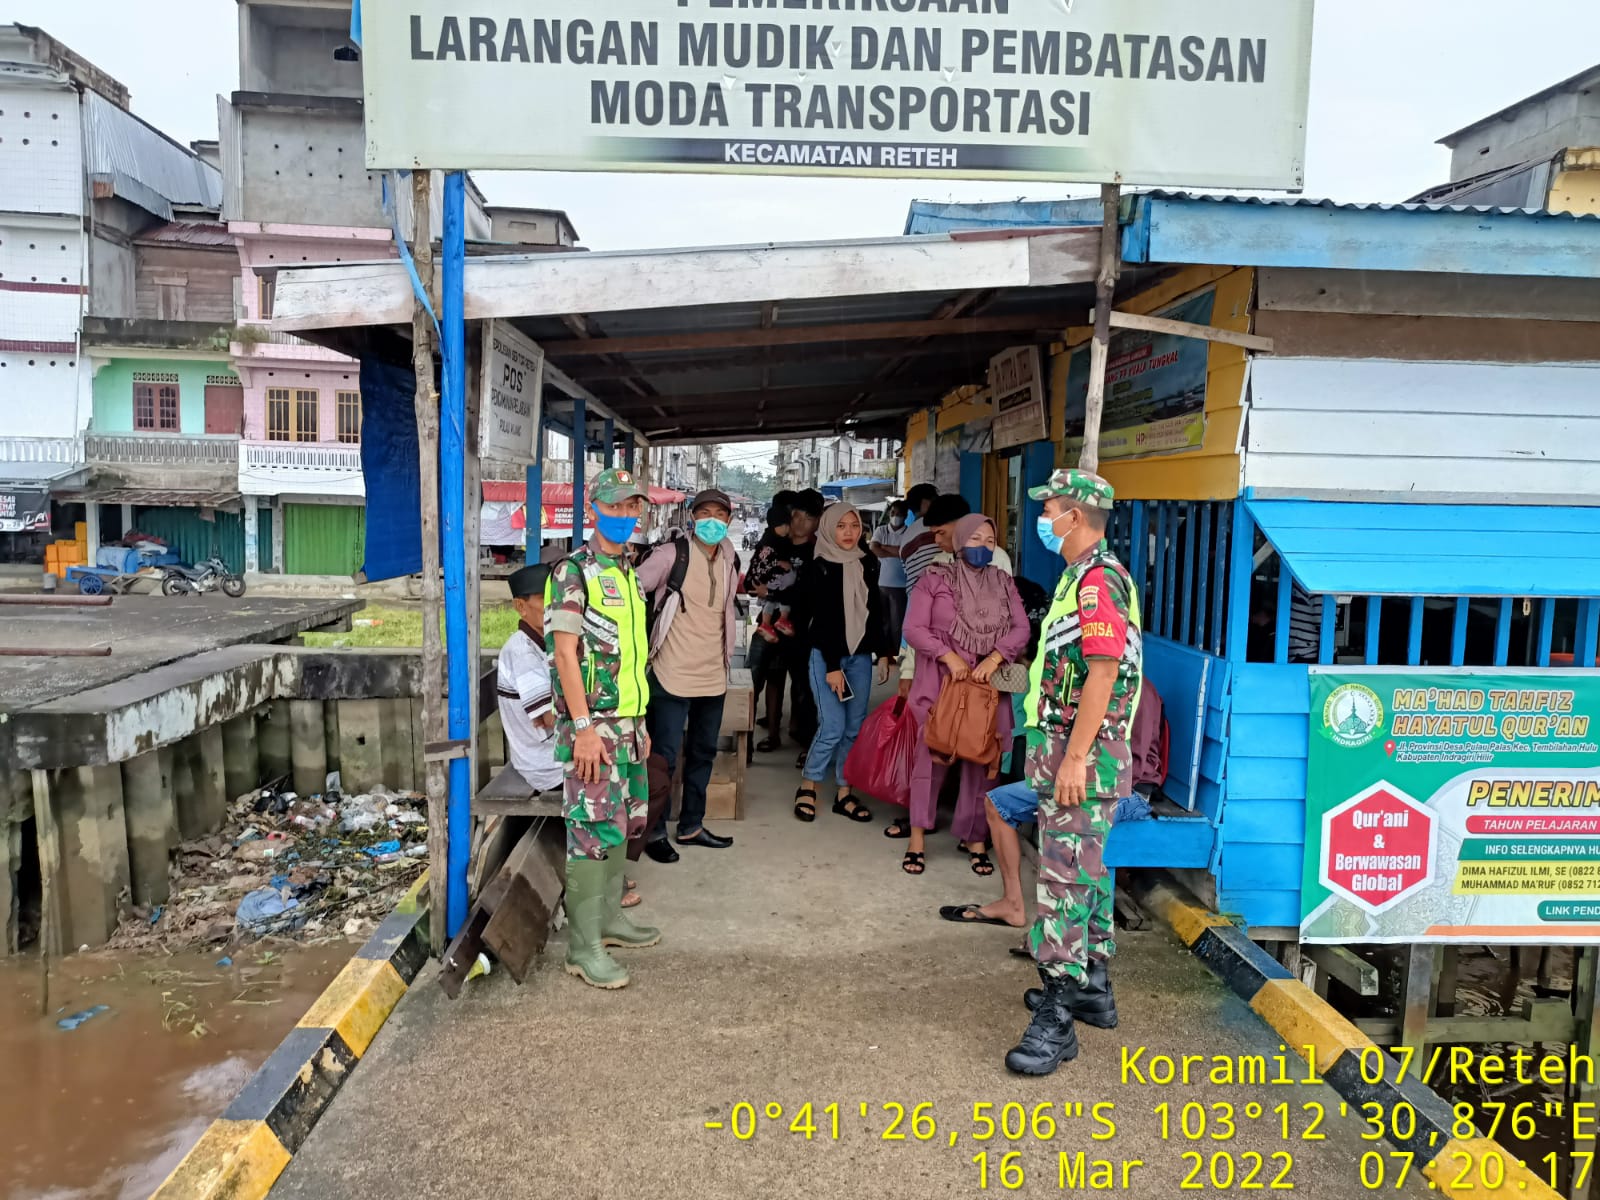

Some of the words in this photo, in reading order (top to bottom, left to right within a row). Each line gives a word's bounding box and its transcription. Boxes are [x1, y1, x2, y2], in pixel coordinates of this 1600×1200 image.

[410, 15, 658, 65] LARANGAN
[679, 22, 833, 70] MUDIK
[851, 26, 941, 72] DAN
[961, 29, 1266, 83] PEMBATASAN
[591, 80, 729, 126] MODA
[745, 83, 1090, 136] TRANSPORTASI
[724, 143, 872, 166] KECAMATAN
[880, 147, 957, 167] RETEH
[503, 363, 523, 393] POS
[1393, 688, 1484, 711] MA'HAD
[1489, 690, 1574, 712] TAHFIZ
[1392, 716, 1497, 736] HAYATUL
[1502, 715, 1589, 740] QUR'AN
[1332, 734, 1373, 746] INDRAGIRI
[1408, 743, 1442, 751] Provinsi
[1443, 743, 1464, 751] Desa
[1465, 743, 1489, 751] Pulau
[1489, 743, 1512, 751] Palas
[1513, 743, 1530, 751] Kec.
[1532, 743, 1578, 751] Tembilahan
[1579, 743, 1598, 751] Hulu
[1397, 753, 1441, 762] Kabupaten
[1442, 753, 1475, 762] Indragiri
[1467, 780, 1600, 807] PENERIM
[1352, 810, 1409, 829] Qur'ani
[1484, 820, 1523, 830] TAHUN
[1526, 820, 1598, 830] PELAJARAN
[1373, 834, 1385, 848] &
[1485, 845, 1508, 855] INFO
[1510, 845, 1586, 855] SELENGKAPNYA
[1335, 853, 1420, 870] Berwawasan
[1462, 867, 1486, 875] DIMA
[1489, 867, 1528, 876] HAFIZUL
[1530, 867, 1552, 877] ILMI,
[1555, 867, 1567, 875] SE
[1568, 866, 1595, 877] (0822
[1352, 874, 1403, 891] Global
[1461, 880, 1519, 889] MUHAMMAD
[1521, 880, 1556, 889] MA'RUF
[1558, 879, 1584, 890] (0852
[1545, 906, 1570, 915] LINK
